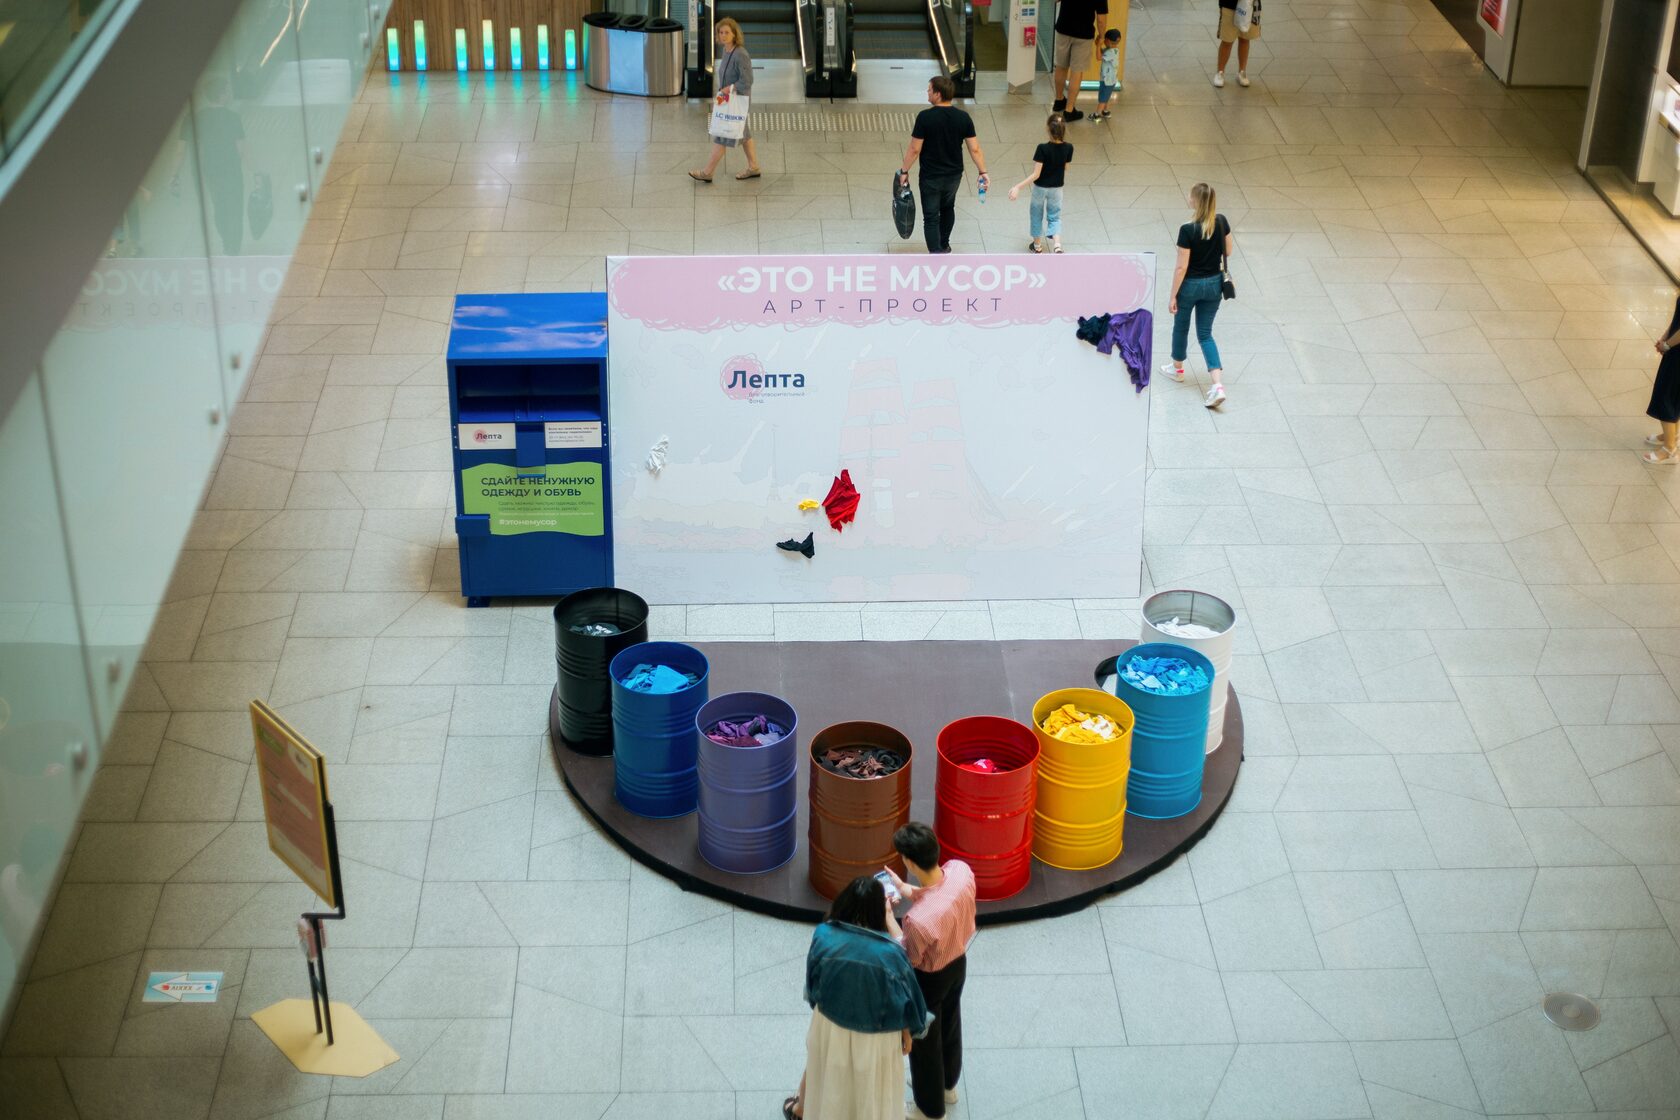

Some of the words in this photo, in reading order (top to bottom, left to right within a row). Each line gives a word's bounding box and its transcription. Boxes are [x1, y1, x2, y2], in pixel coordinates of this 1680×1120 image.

[718, 266, 814, 293] «ЭТО
[827, 265, 877, 292] НЕ
[890, 264, 1047, 292] МУСОР»
[763, 298, 1002, 313] АРТ-ПРОЕКТ
[728, 370, 805, 389] Лепта
[481, 476, 525, 486] СДАЙТЕ
[528, 477, 595, 485] НЕНУЖНУЮ
[481, 488, 531, 498] ОДЕЖДУ
[544, 488, 582, 496] ОБУВЬ
